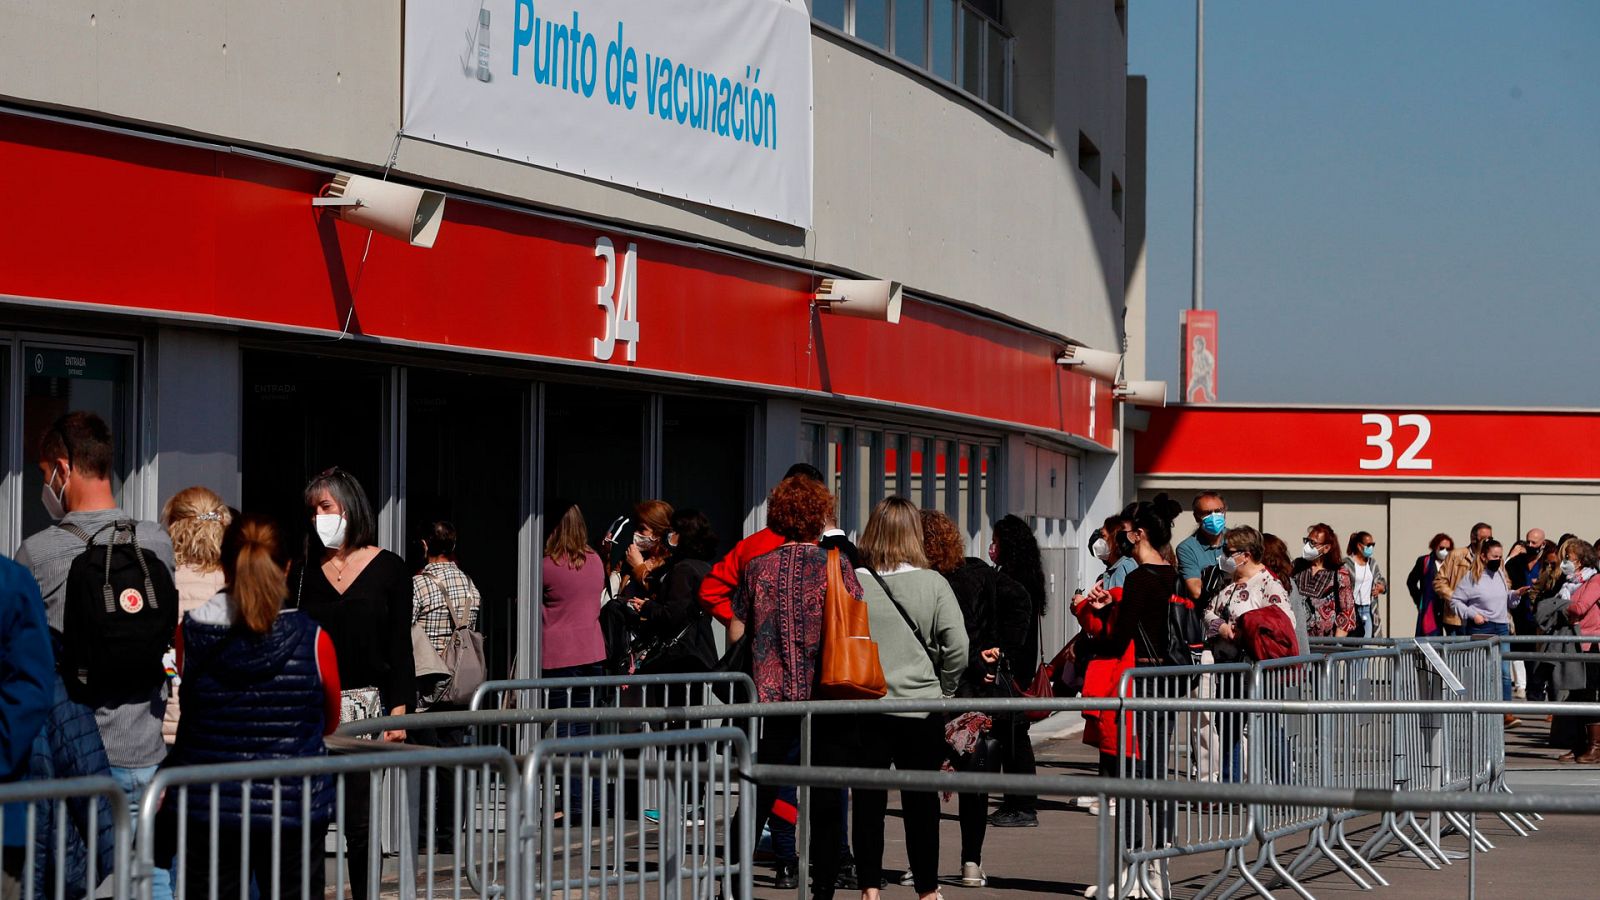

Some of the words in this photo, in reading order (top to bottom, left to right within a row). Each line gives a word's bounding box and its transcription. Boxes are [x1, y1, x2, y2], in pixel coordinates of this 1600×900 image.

[512, 0, 598, 97] Punto
[605, 21, 638, 110] de
[645, 53, 777, 150] vacunación
[593, 236, 639, 361] 34
[65, 356, 86, 367] ENTRADA
[1360, 413, 1432, 470] 32
